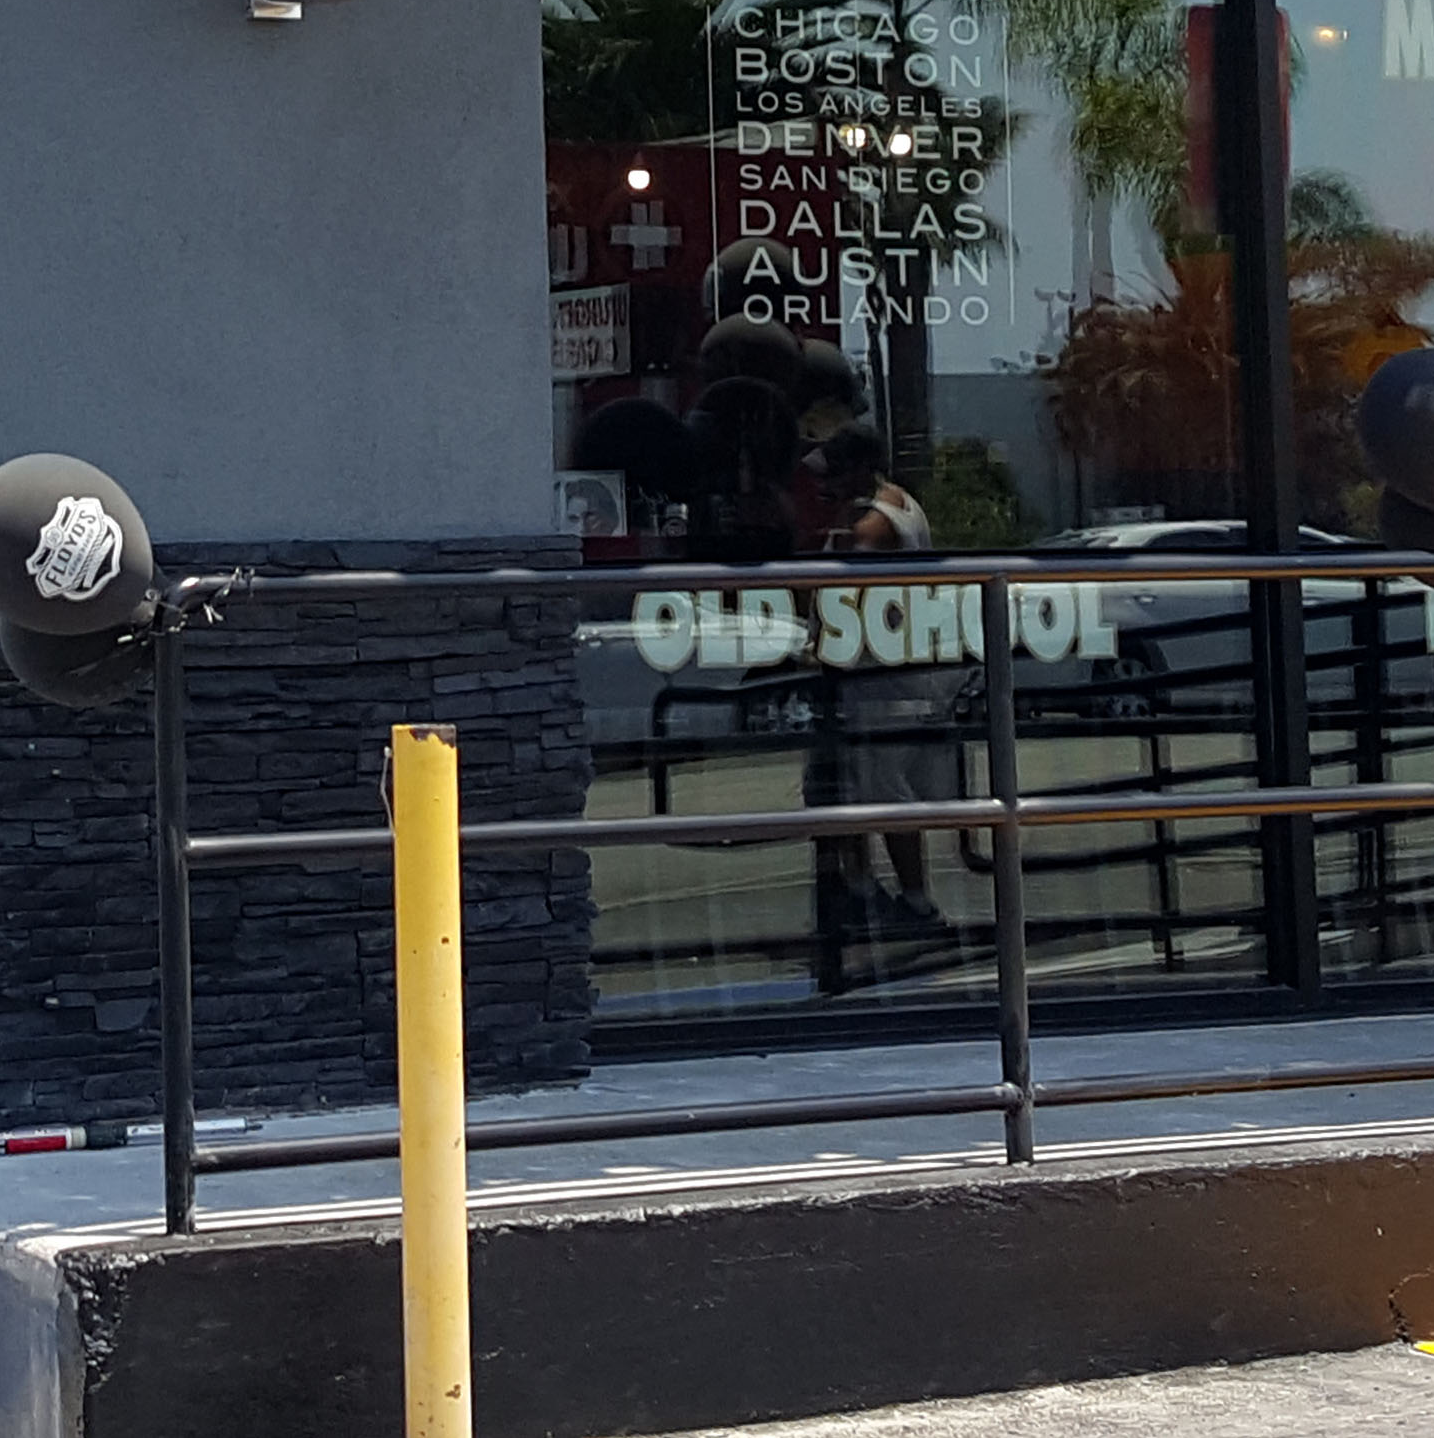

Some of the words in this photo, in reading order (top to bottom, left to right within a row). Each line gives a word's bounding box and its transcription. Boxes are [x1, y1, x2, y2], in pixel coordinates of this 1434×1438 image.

[735, 7, 979, 46] CHICAGO
[736, 47, 981, 89] BOSTON
[736, 91, 804, 113] LOS
[819, 92, 982, 118] ANGELES
[737, 120, 983, 161] DENVER
[740, 164, 827, 192] SAN
[848, 168, 985, 195] DIEGO
[740, 200, 987, 240] DALLAS
[743, 247, 989, 287] AUSTIN
[743, 294, 989, 326] ORLANDO
[45, 509, 98, 588] FLOYD'S
[632, 588, 796, 673] OLD
